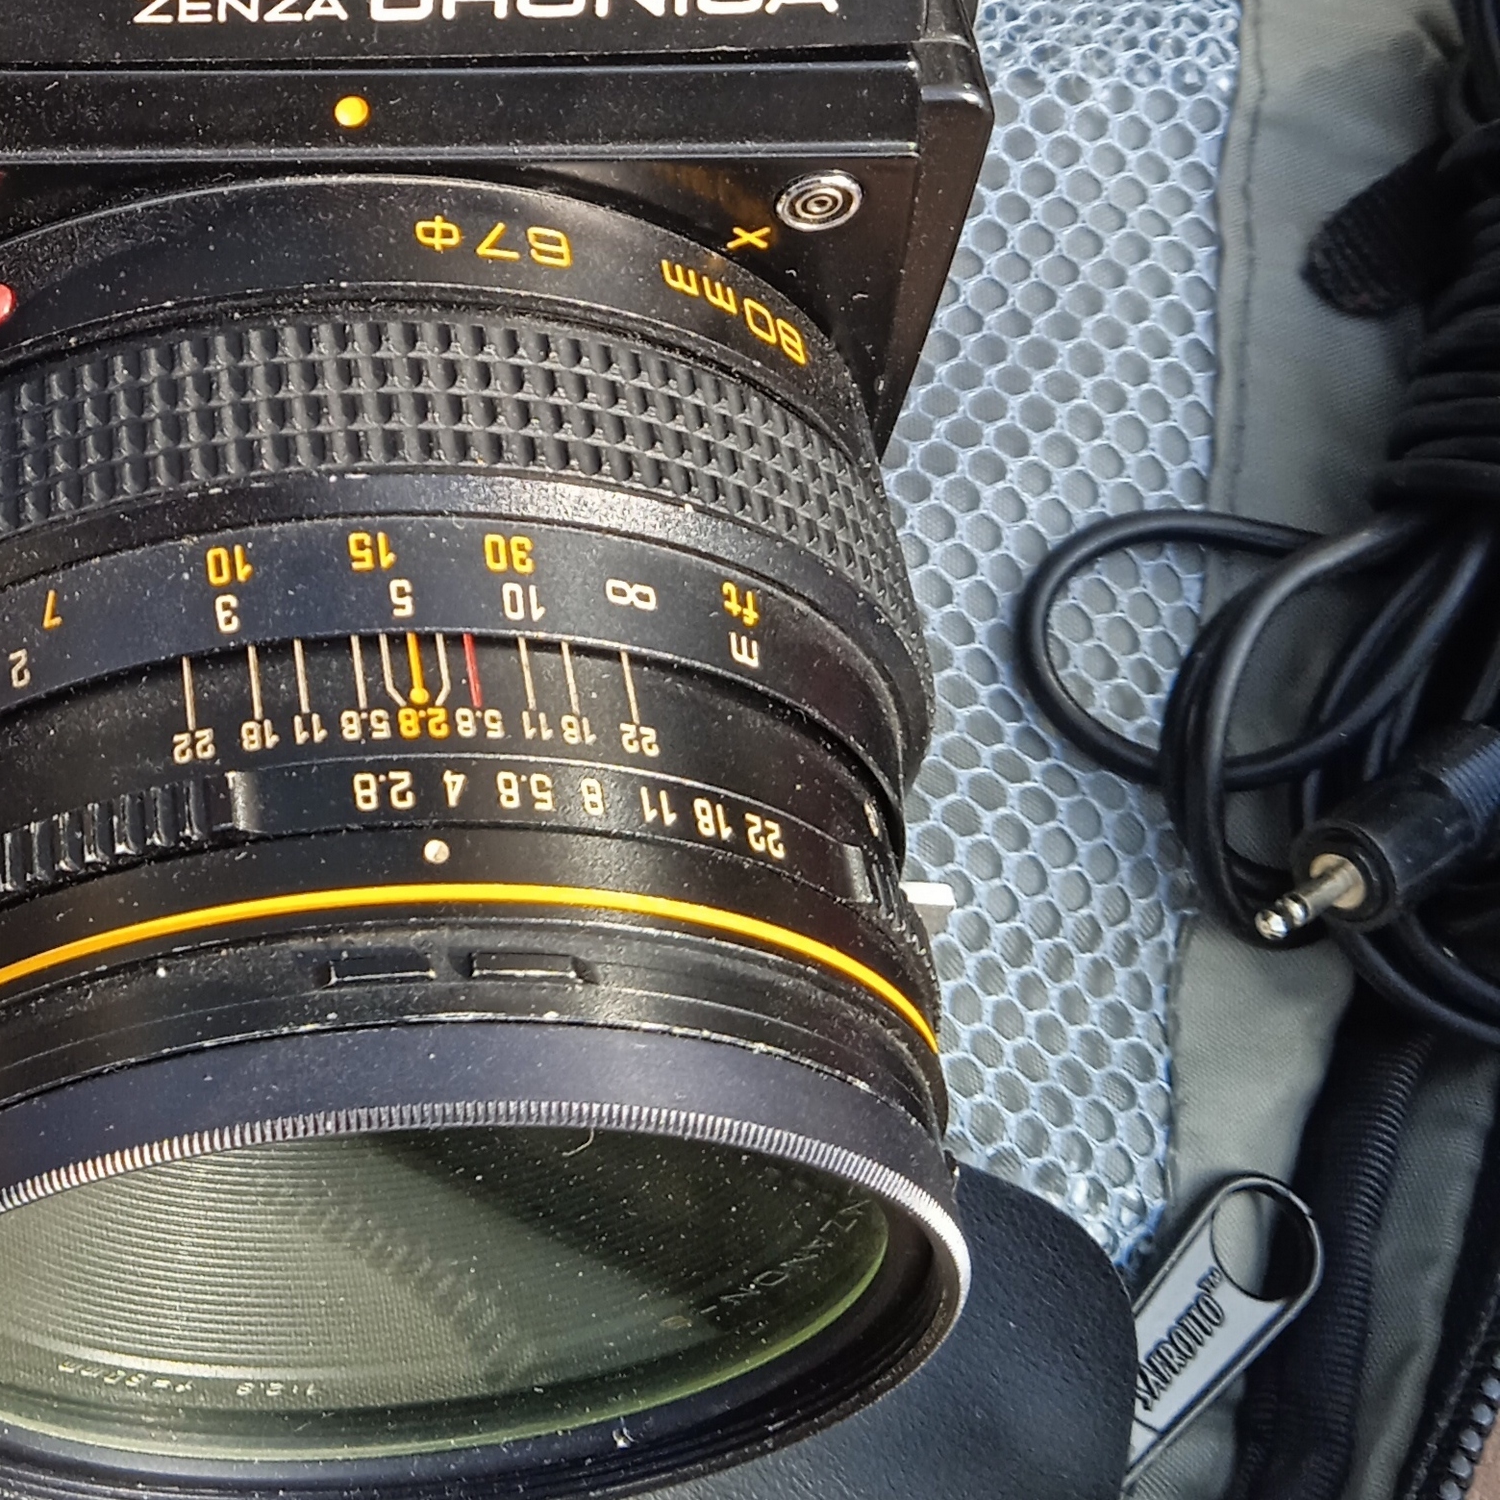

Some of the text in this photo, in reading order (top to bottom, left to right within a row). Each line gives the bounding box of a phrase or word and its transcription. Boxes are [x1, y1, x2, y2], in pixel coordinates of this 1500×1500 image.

[660, 258, 808, 366] 80mm
[206, 544, 254, 587] 10
[347, 531, 397, 572] 15
[484, 534, 535, 575] 30
[42, 589, 64, 631] 7
[214, 593, 240, 634] 3
[389, 578, 415, 618] 5
[502, 582, 546, 622] 10
[721, 581, 760, 628] ft
[8, 648, 32, 689] 2
[730, 631, 760, 669] m
[172, 706, 660, 765] 22 16 11 5.6 2.8 5.6 11 16 22
[353, 769, 786, 859] 22 16 11 8 5.6 4 2.8
